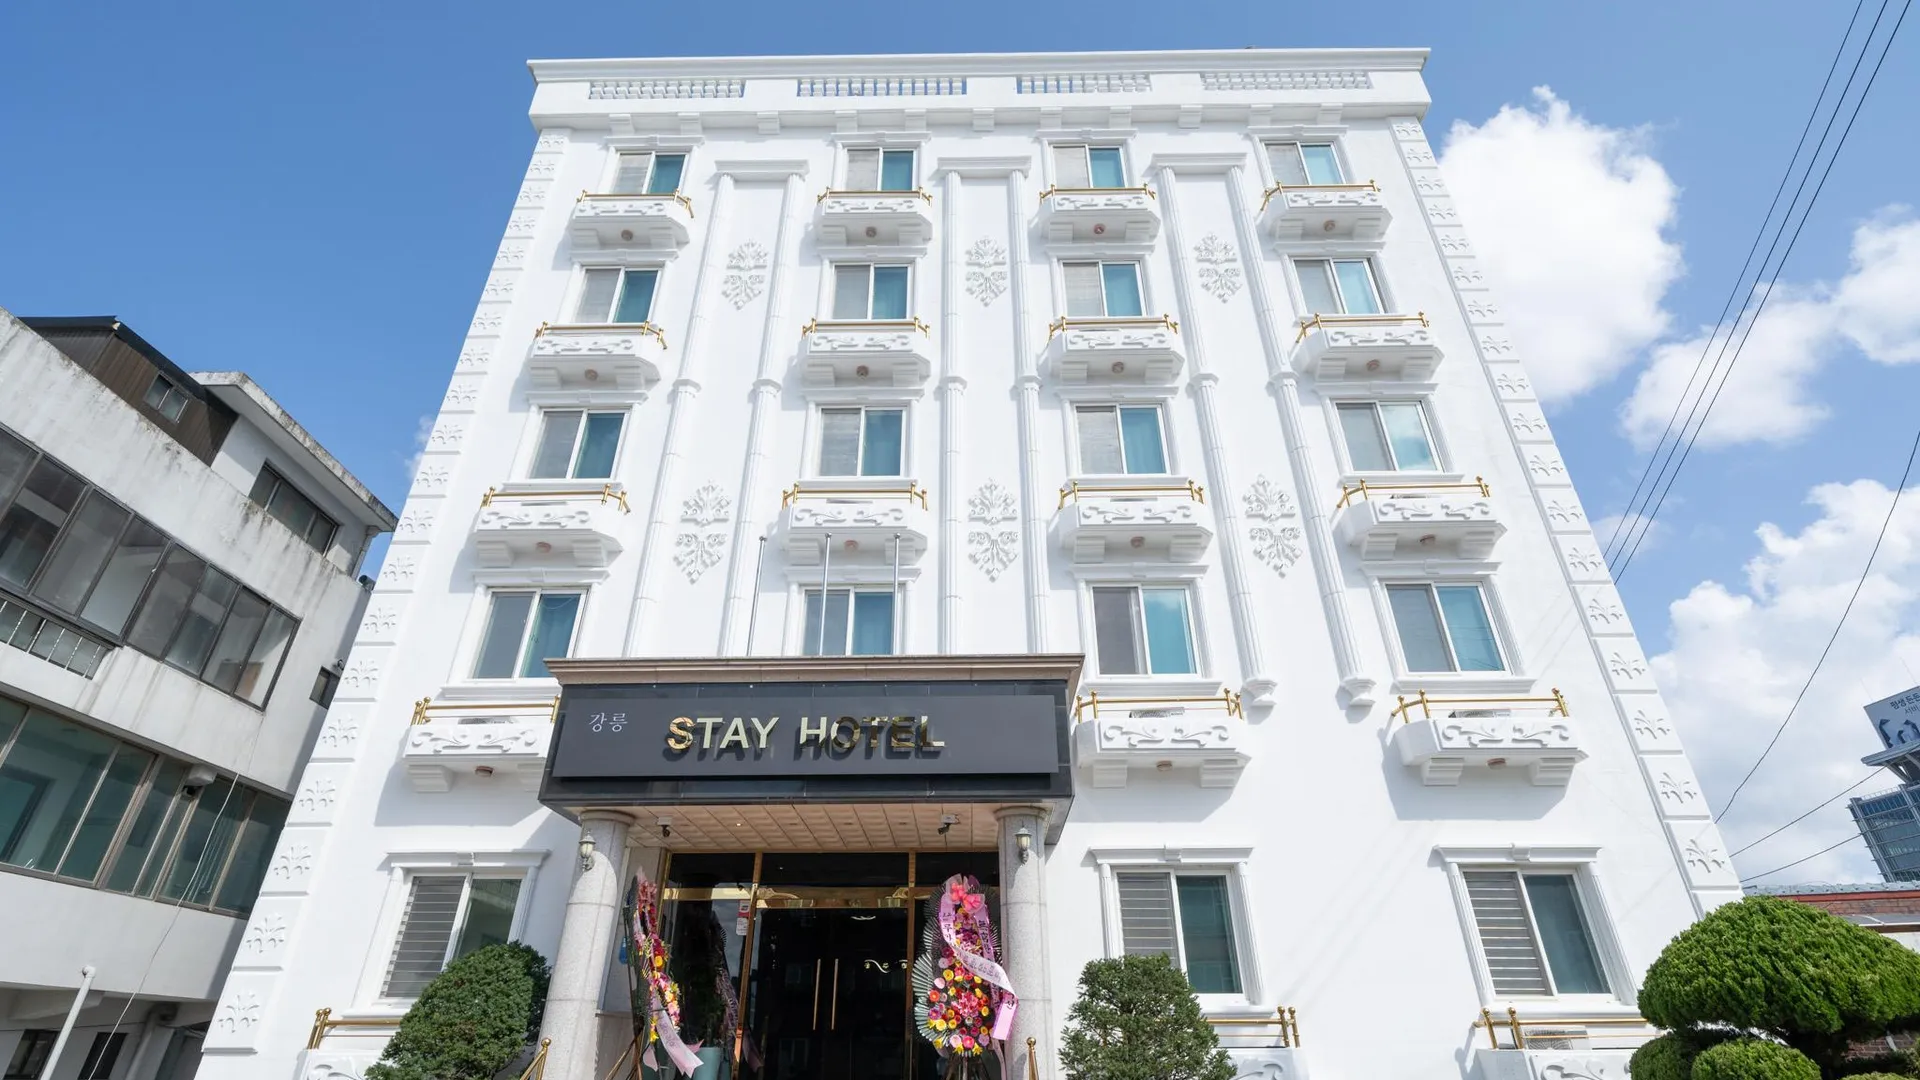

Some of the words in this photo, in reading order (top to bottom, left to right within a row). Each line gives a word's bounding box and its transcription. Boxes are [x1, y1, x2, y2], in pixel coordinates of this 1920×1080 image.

[589, 712, 628, 733] 강릉
[667, 716, 780, 750] STAY
[800, 715, 946, 750] HOTEL
